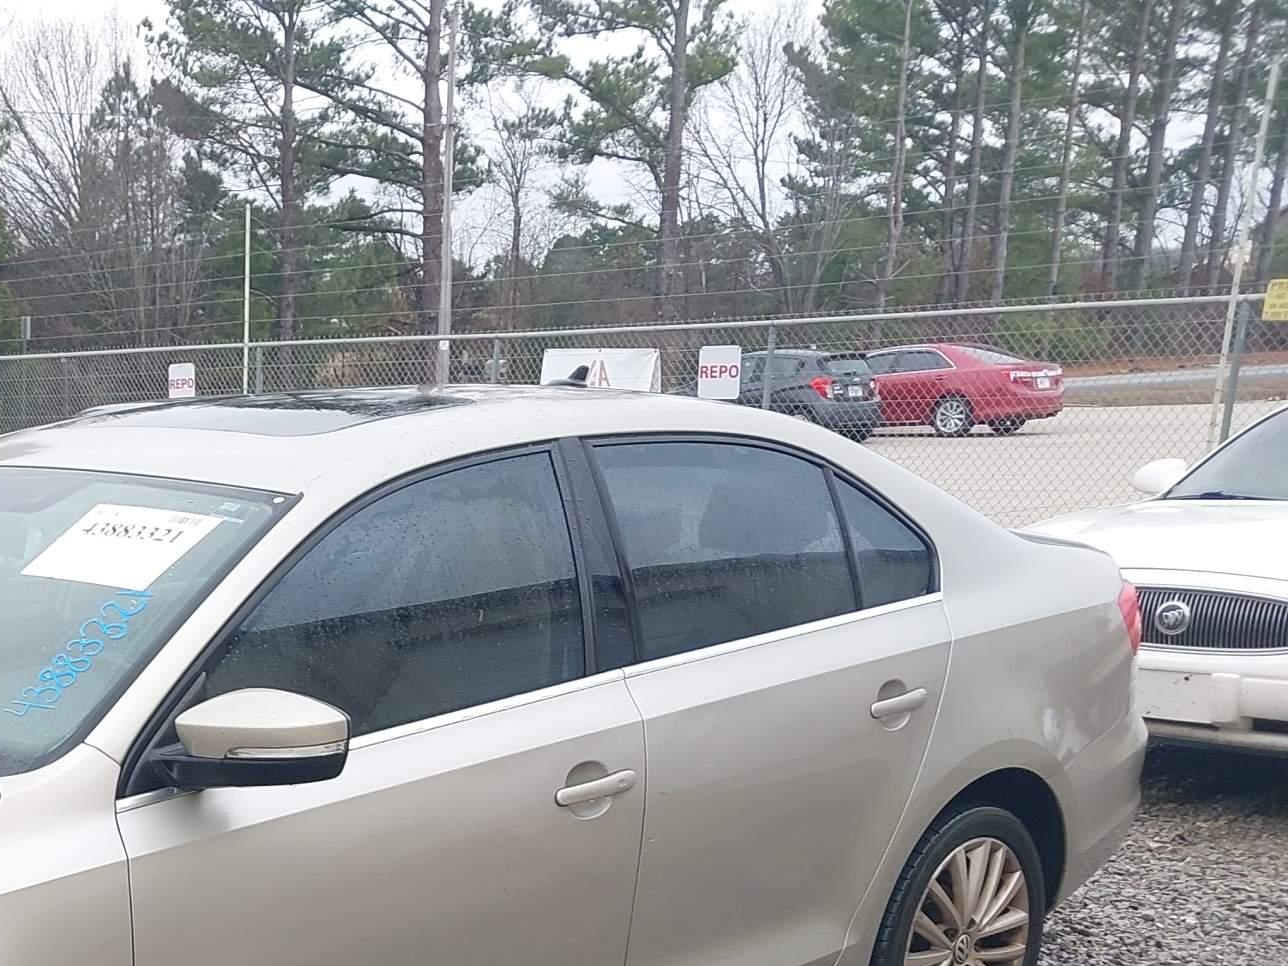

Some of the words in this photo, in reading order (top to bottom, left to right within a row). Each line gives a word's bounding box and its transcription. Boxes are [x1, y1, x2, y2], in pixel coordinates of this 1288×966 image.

[699, 364, 739, 379] REPO
[169, 377, 194, 390] REPO
[82, 521, 184, 544] 43883321
[3, 590, 154, 718] 43883321
